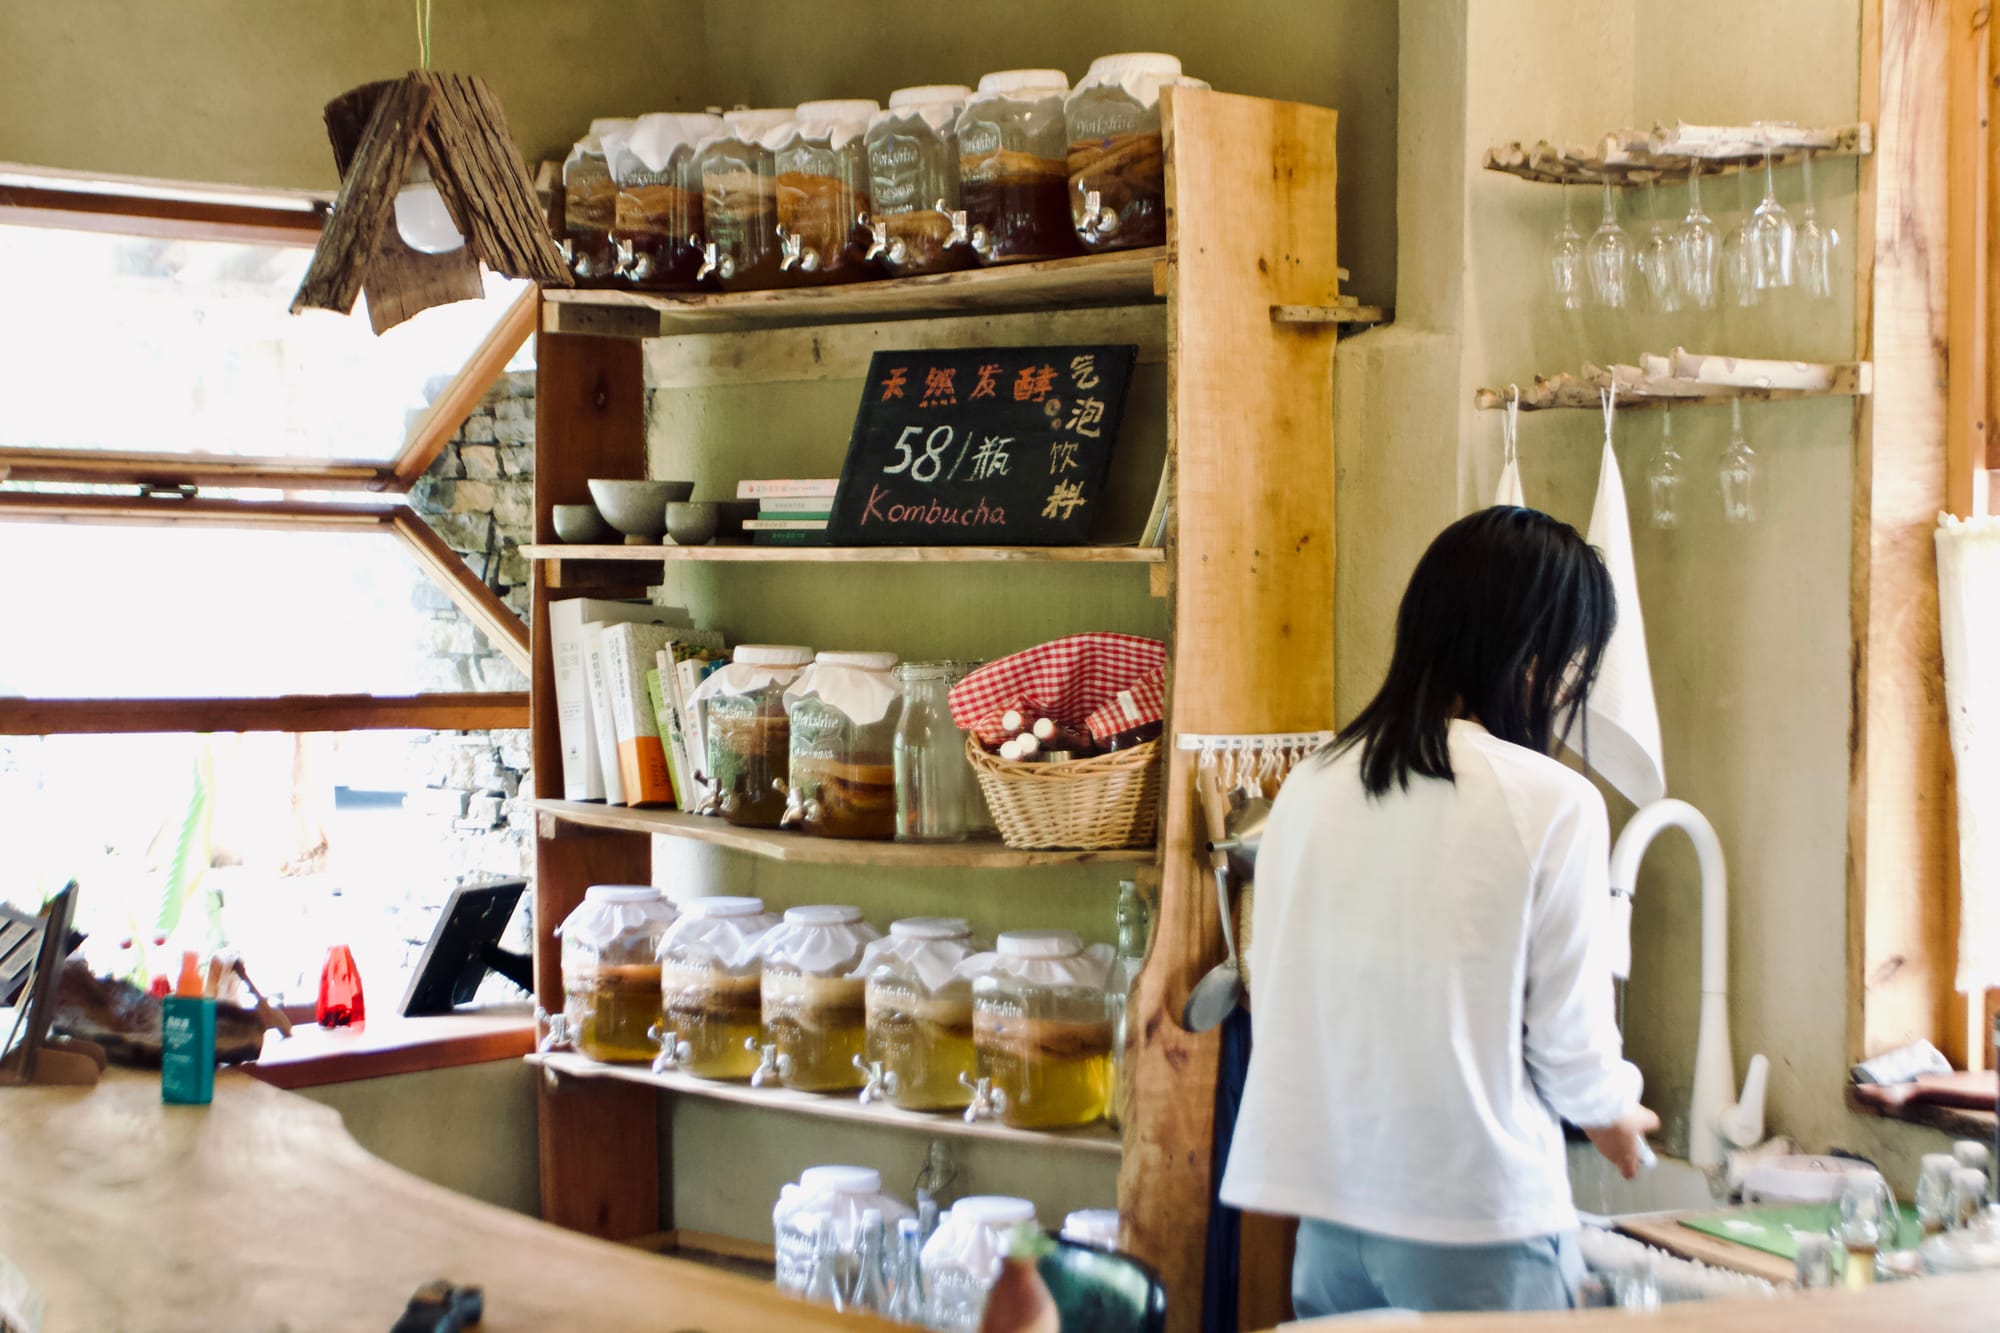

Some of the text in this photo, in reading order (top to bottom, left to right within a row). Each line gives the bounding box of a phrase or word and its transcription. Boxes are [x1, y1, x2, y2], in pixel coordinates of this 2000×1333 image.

[880, 363, 1059, 408] 天然发酵
[1041, 353, 1105, 521] 气泡饮料
[860, 482, 1007, 527] Kombucha
